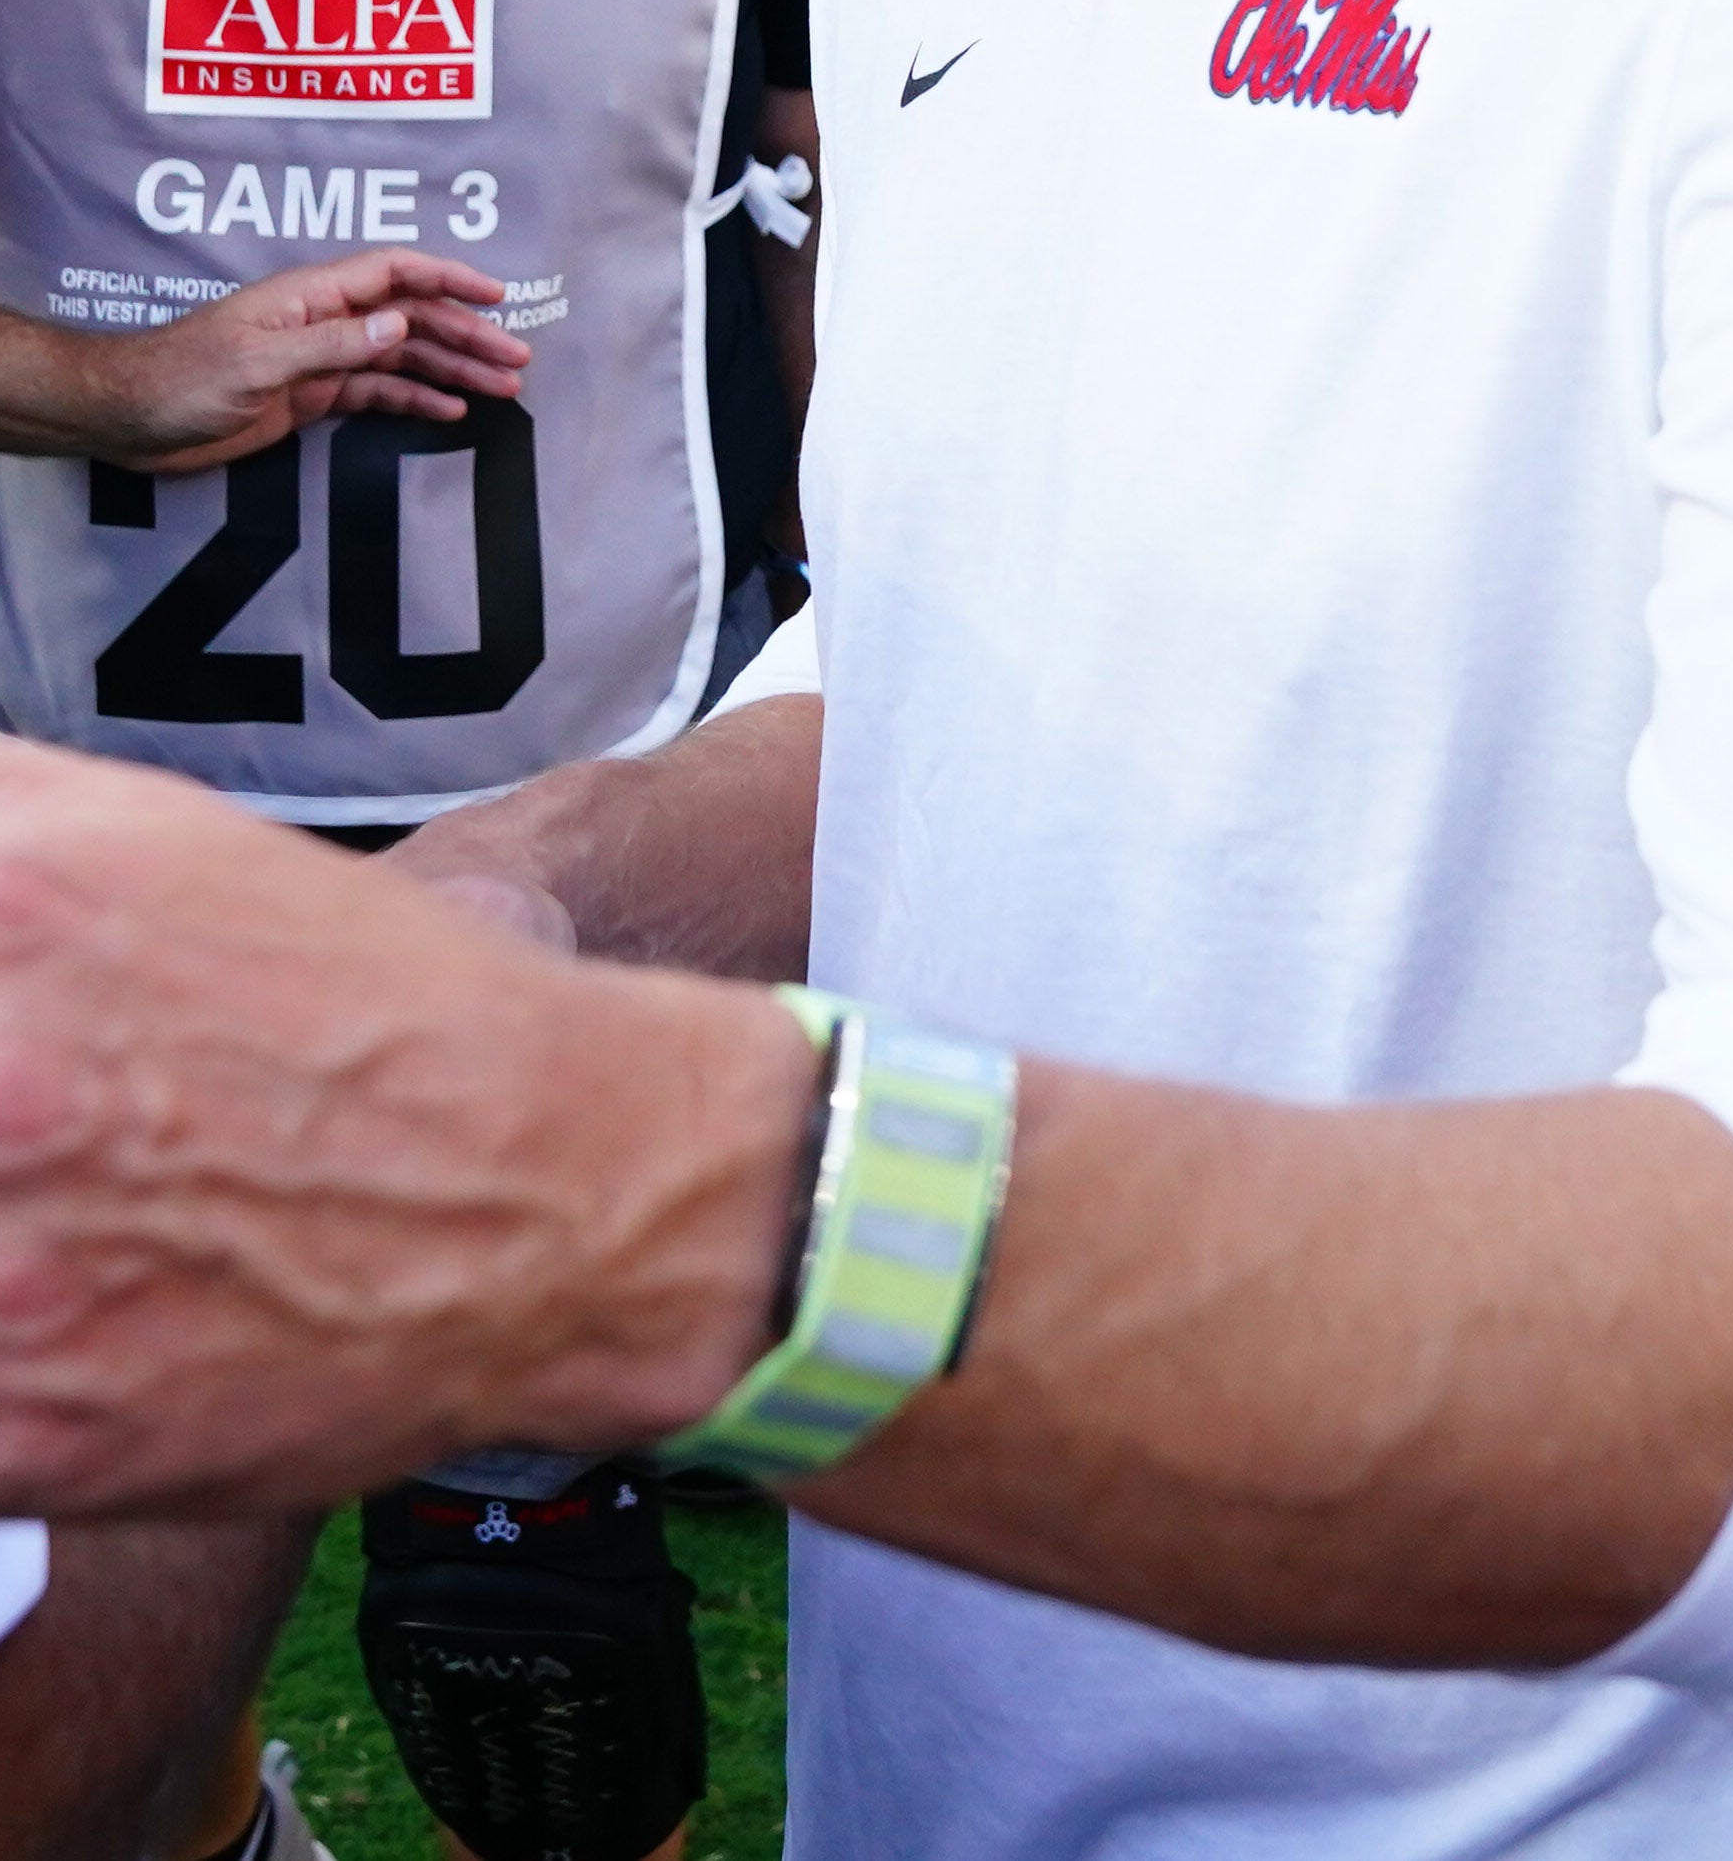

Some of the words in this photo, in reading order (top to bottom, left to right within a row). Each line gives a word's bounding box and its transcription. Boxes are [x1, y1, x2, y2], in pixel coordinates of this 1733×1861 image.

[177, 64, 463, 98] INSURANCE
[135, 157, 419, 242] GAME
[448, 169, 499, 241] 3
[60, 267, 150, 296] OFFICIAL
[504, 274, 564, 303] RABLE
[47, 292, 89, 321] THIS
[93, 298, 147, 325] VEST
[505, 297, 569, 330] ACCESS
[90, 394, 546, 724] 20
